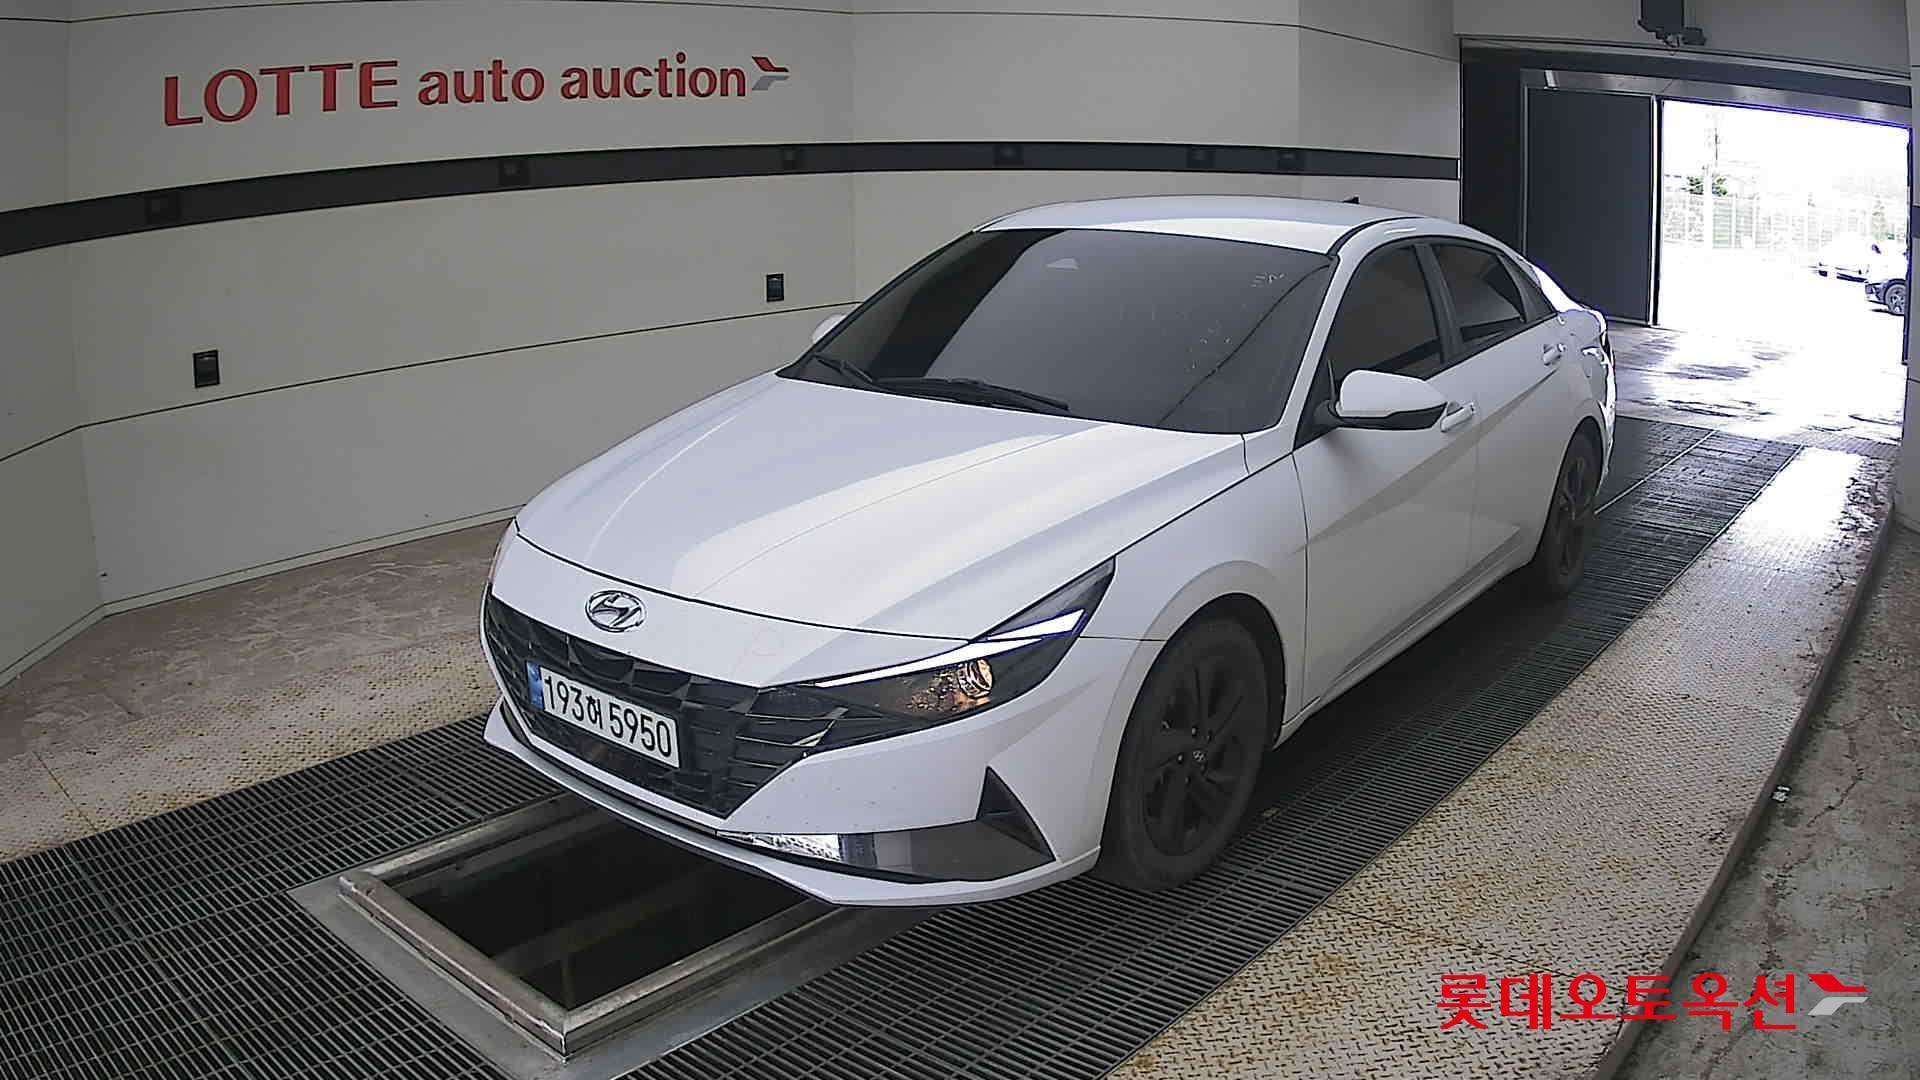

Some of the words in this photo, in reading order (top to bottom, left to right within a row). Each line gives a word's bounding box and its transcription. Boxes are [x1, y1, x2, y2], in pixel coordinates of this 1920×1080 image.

[165, 60, 399, 126] LOTTE
[418, 59, 545, 106] auto
[560, 51, 747, 100] auction
[608, 702, 673, 758] 5950
